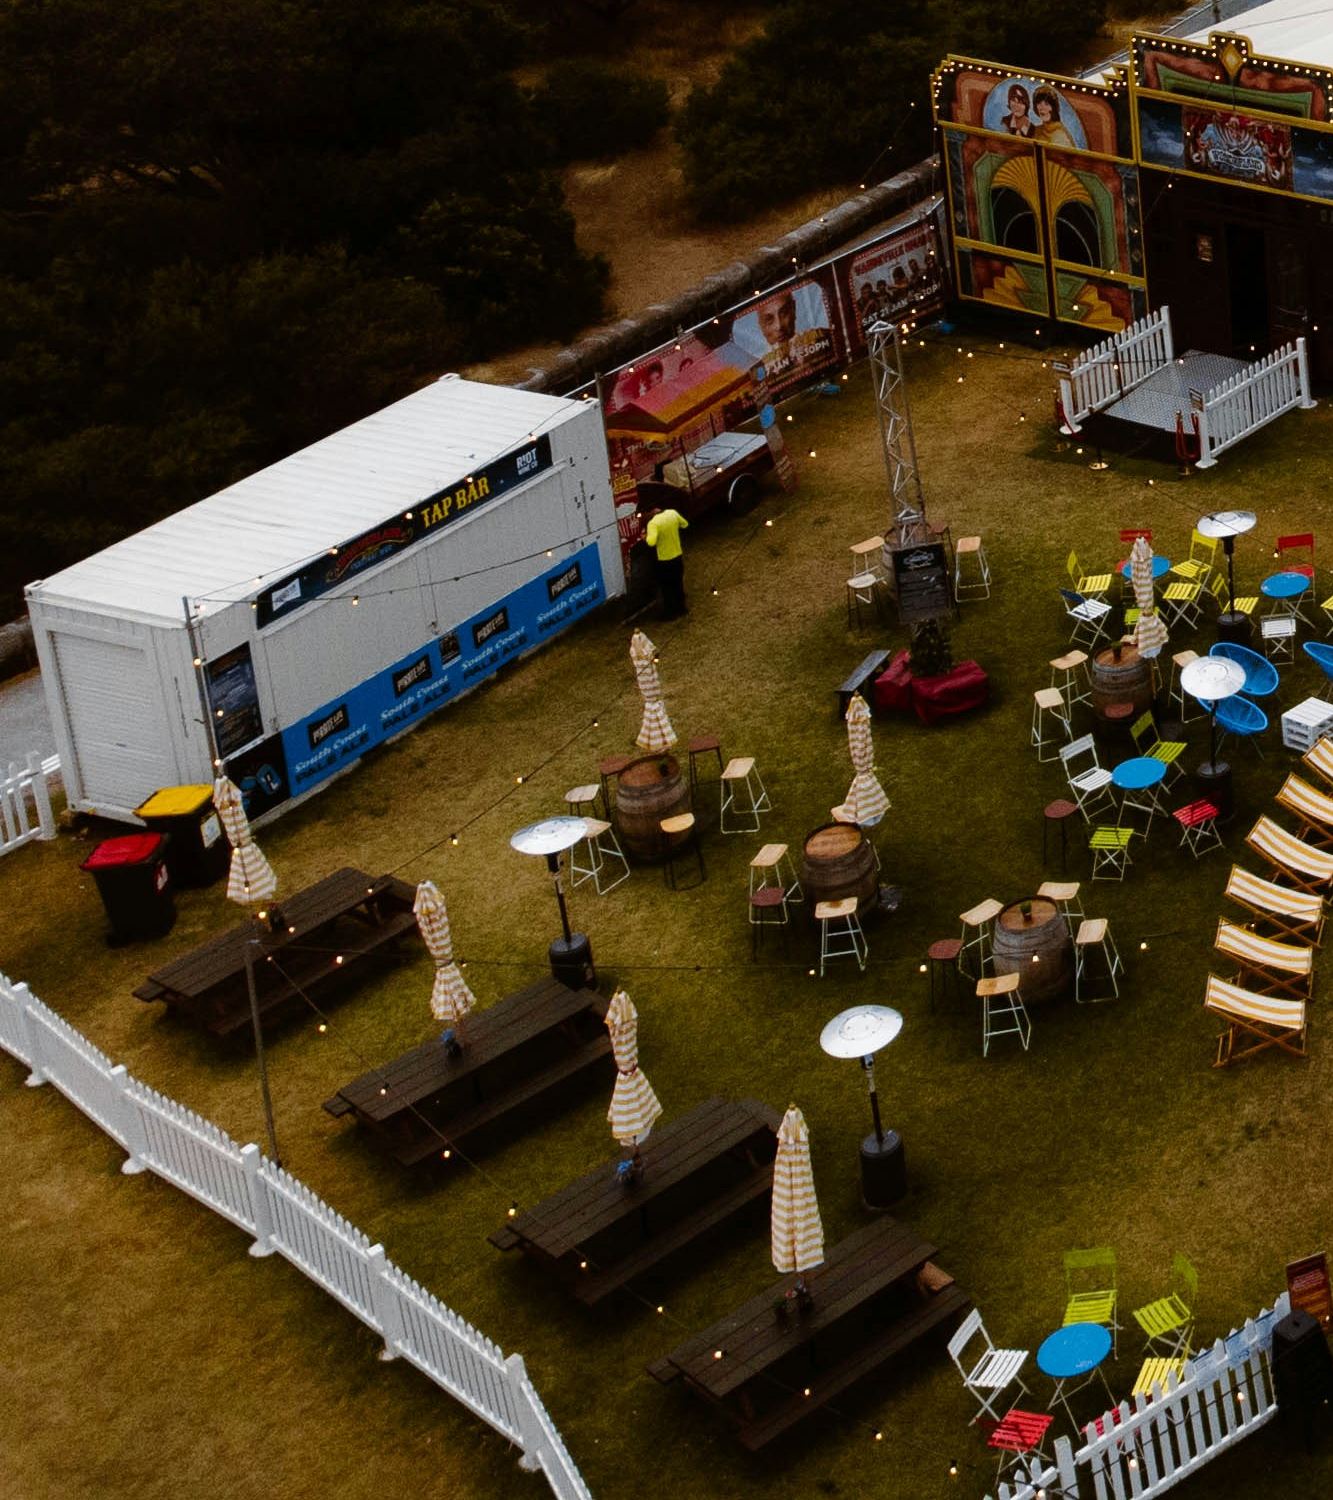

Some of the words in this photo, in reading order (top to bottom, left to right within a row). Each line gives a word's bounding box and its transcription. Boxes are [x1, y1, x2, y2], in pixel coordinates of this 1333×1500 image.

[421, 498, 452, 529] TAP
[455, 476, 490, 510] BAR
[536, 601, 567, 624] South
[569, 581, 598, 603] Coast
[461, 647, 493, 671] South
[495, 626, 525, 649] Coast
[381, 696, 415, 719] South
[417, 675, 448, 698] Coast
[295, 748, 331, 772] South
[333, 723, 368, 749] Coast
